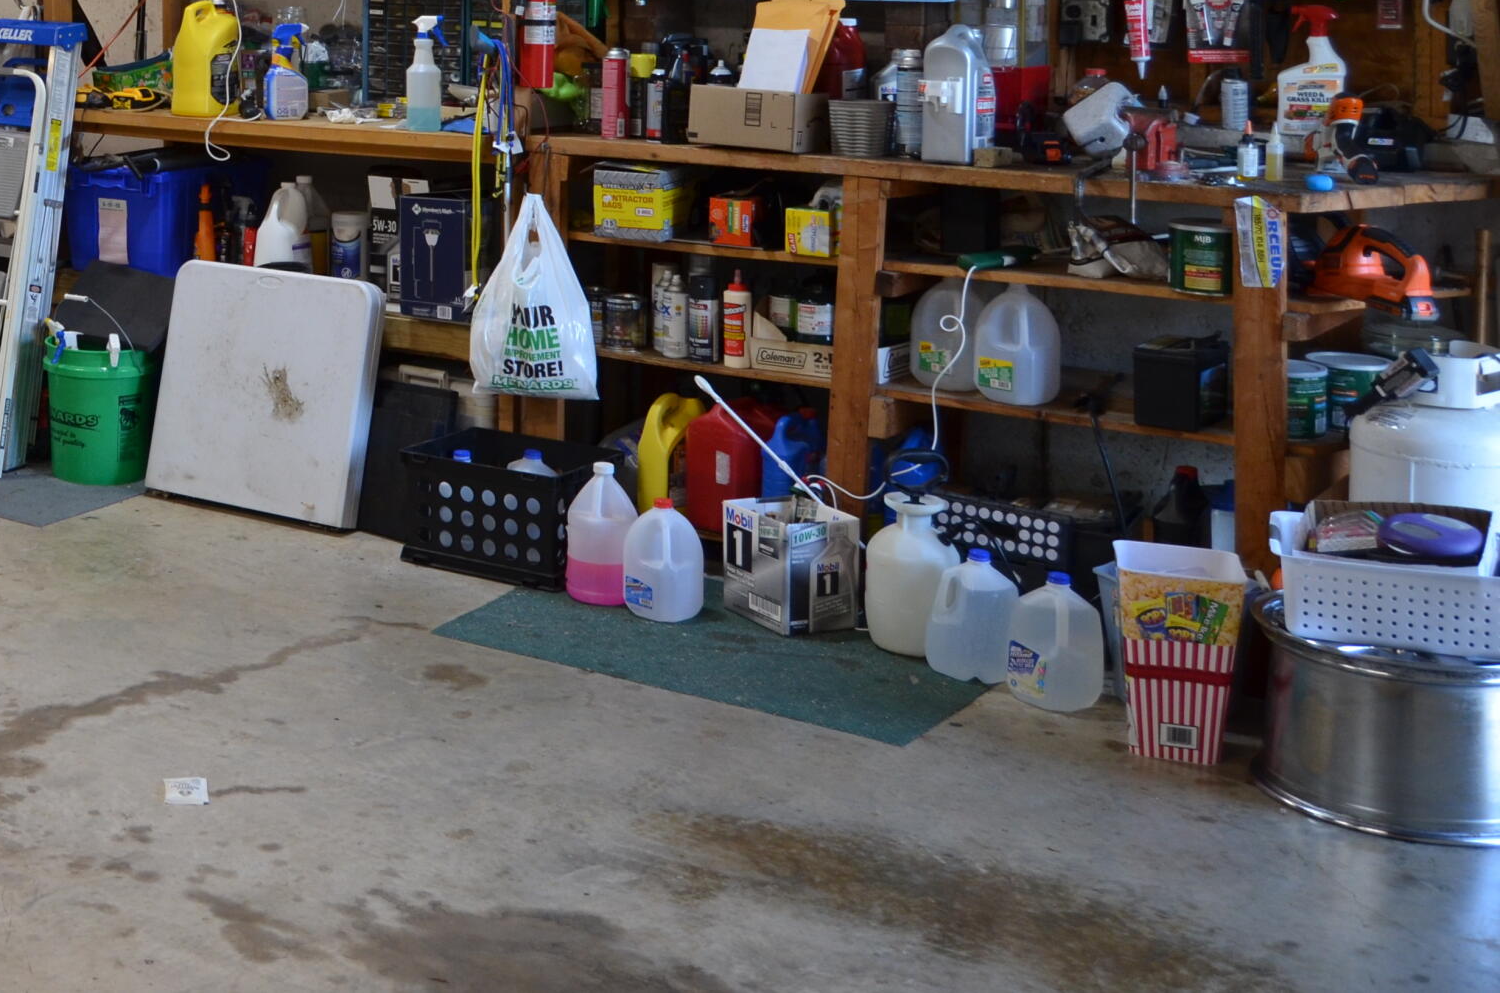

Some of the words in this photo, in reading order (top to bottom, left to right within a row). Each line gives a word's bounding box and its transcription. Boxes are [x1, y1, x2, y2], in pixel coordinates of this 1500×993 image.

[1311, 96, 1333, 104] KILLE
[602, 194, 653, 205] NTRACTOR
[373, 219, 397, 233] 5W-30
[788, 233, 797, 254] GLAD
[506, 327, 561, 351] HOME
[504, 348, 562, 362] IMPROVEMENT
[760, 350, 796, 364] Coleman
[502, 358, 564, 379] STORE!
[491, 374, 574, 391] MENARDS
[726, 506, 753, 531] Mobil
[793, 527, 828, 545] 10W-30
[733, 529, 743, 567] 1
[817, 562, 840, 573] Mobil
[823, 573, 831, 595] 1
